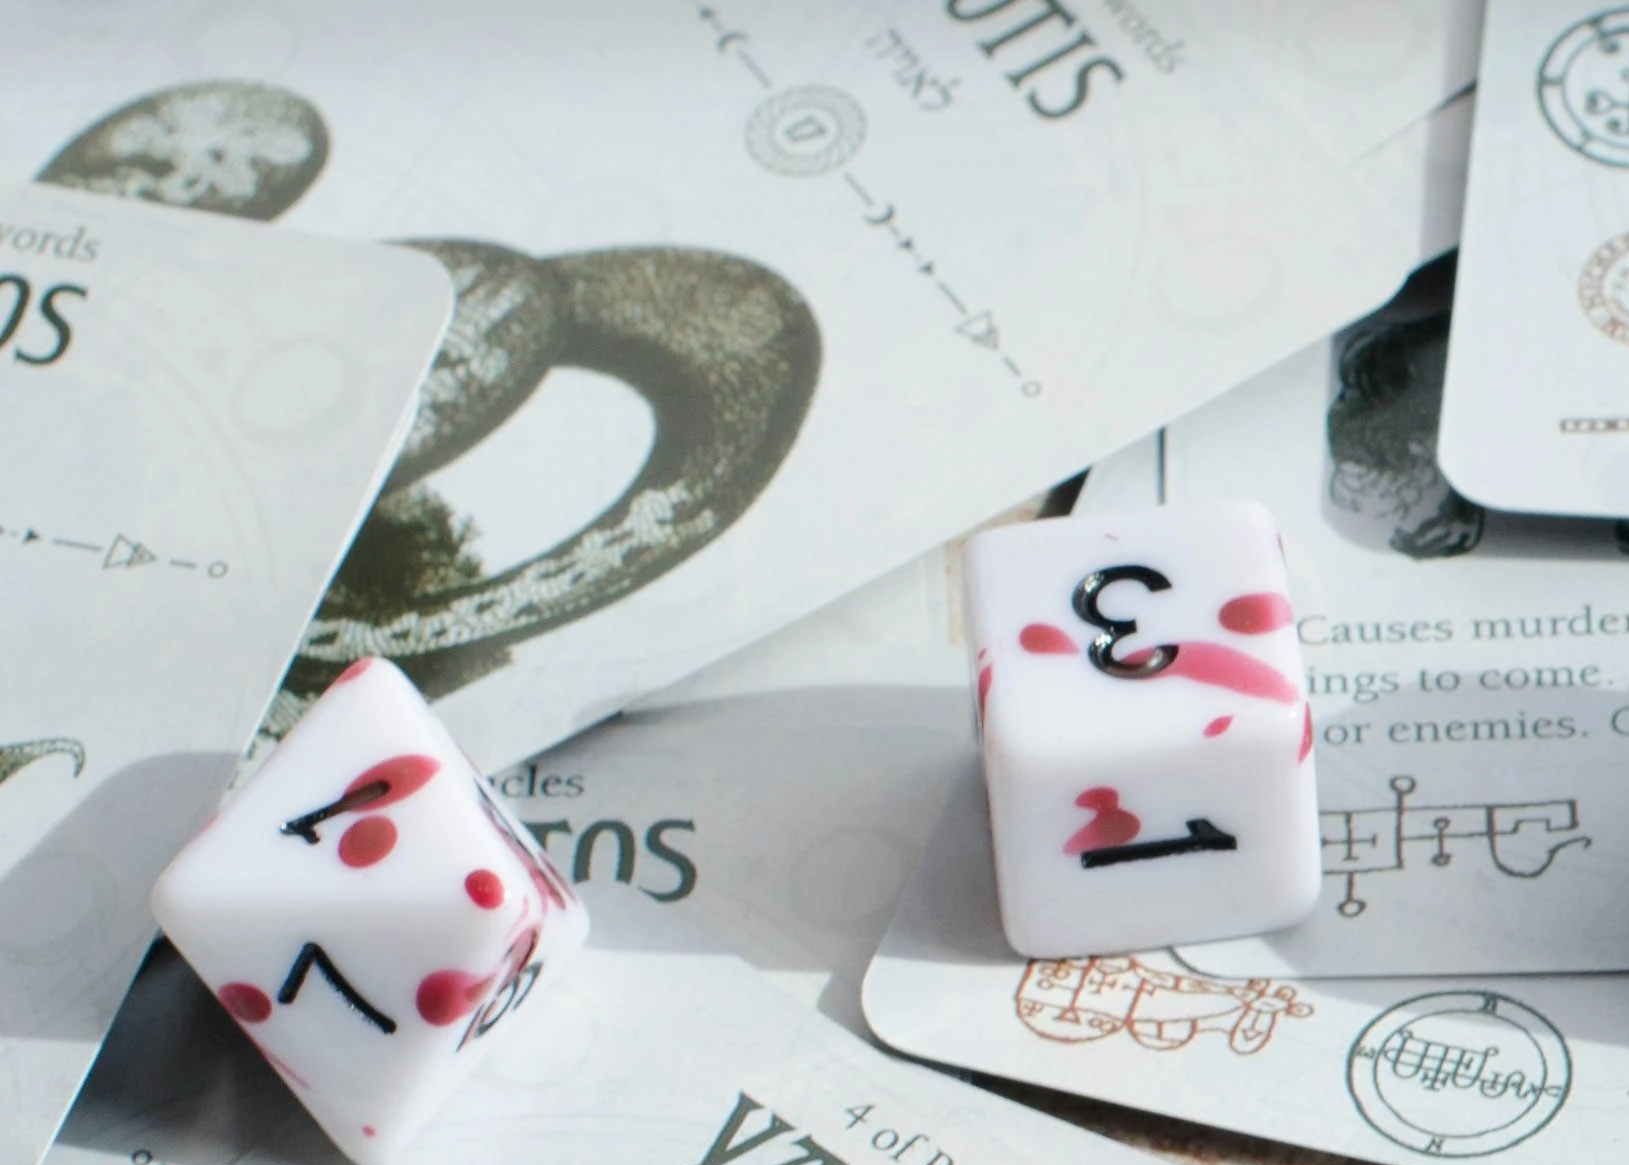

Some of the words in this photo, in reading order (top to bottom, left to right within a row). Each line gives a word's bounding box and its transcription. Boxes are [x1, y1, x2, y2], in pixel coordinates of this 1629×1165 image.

[0, 222, 101, 263] ords
[1072, 563, 1179, 679] 3
[1297, 613, 1454, 647] Causes
[1418, 669, 1462, 693] to
[1479, 663, 1614, 691] come.
[1323, 724, 1371, 746] or
[1388, 711, 1590, 744] enemies.
[486, 764, 586, 798] cles
[1080, 818, 1238, 869] 1
[844, 1103, 876, 1130] 4
[871, 1127, 930, 1163] of
